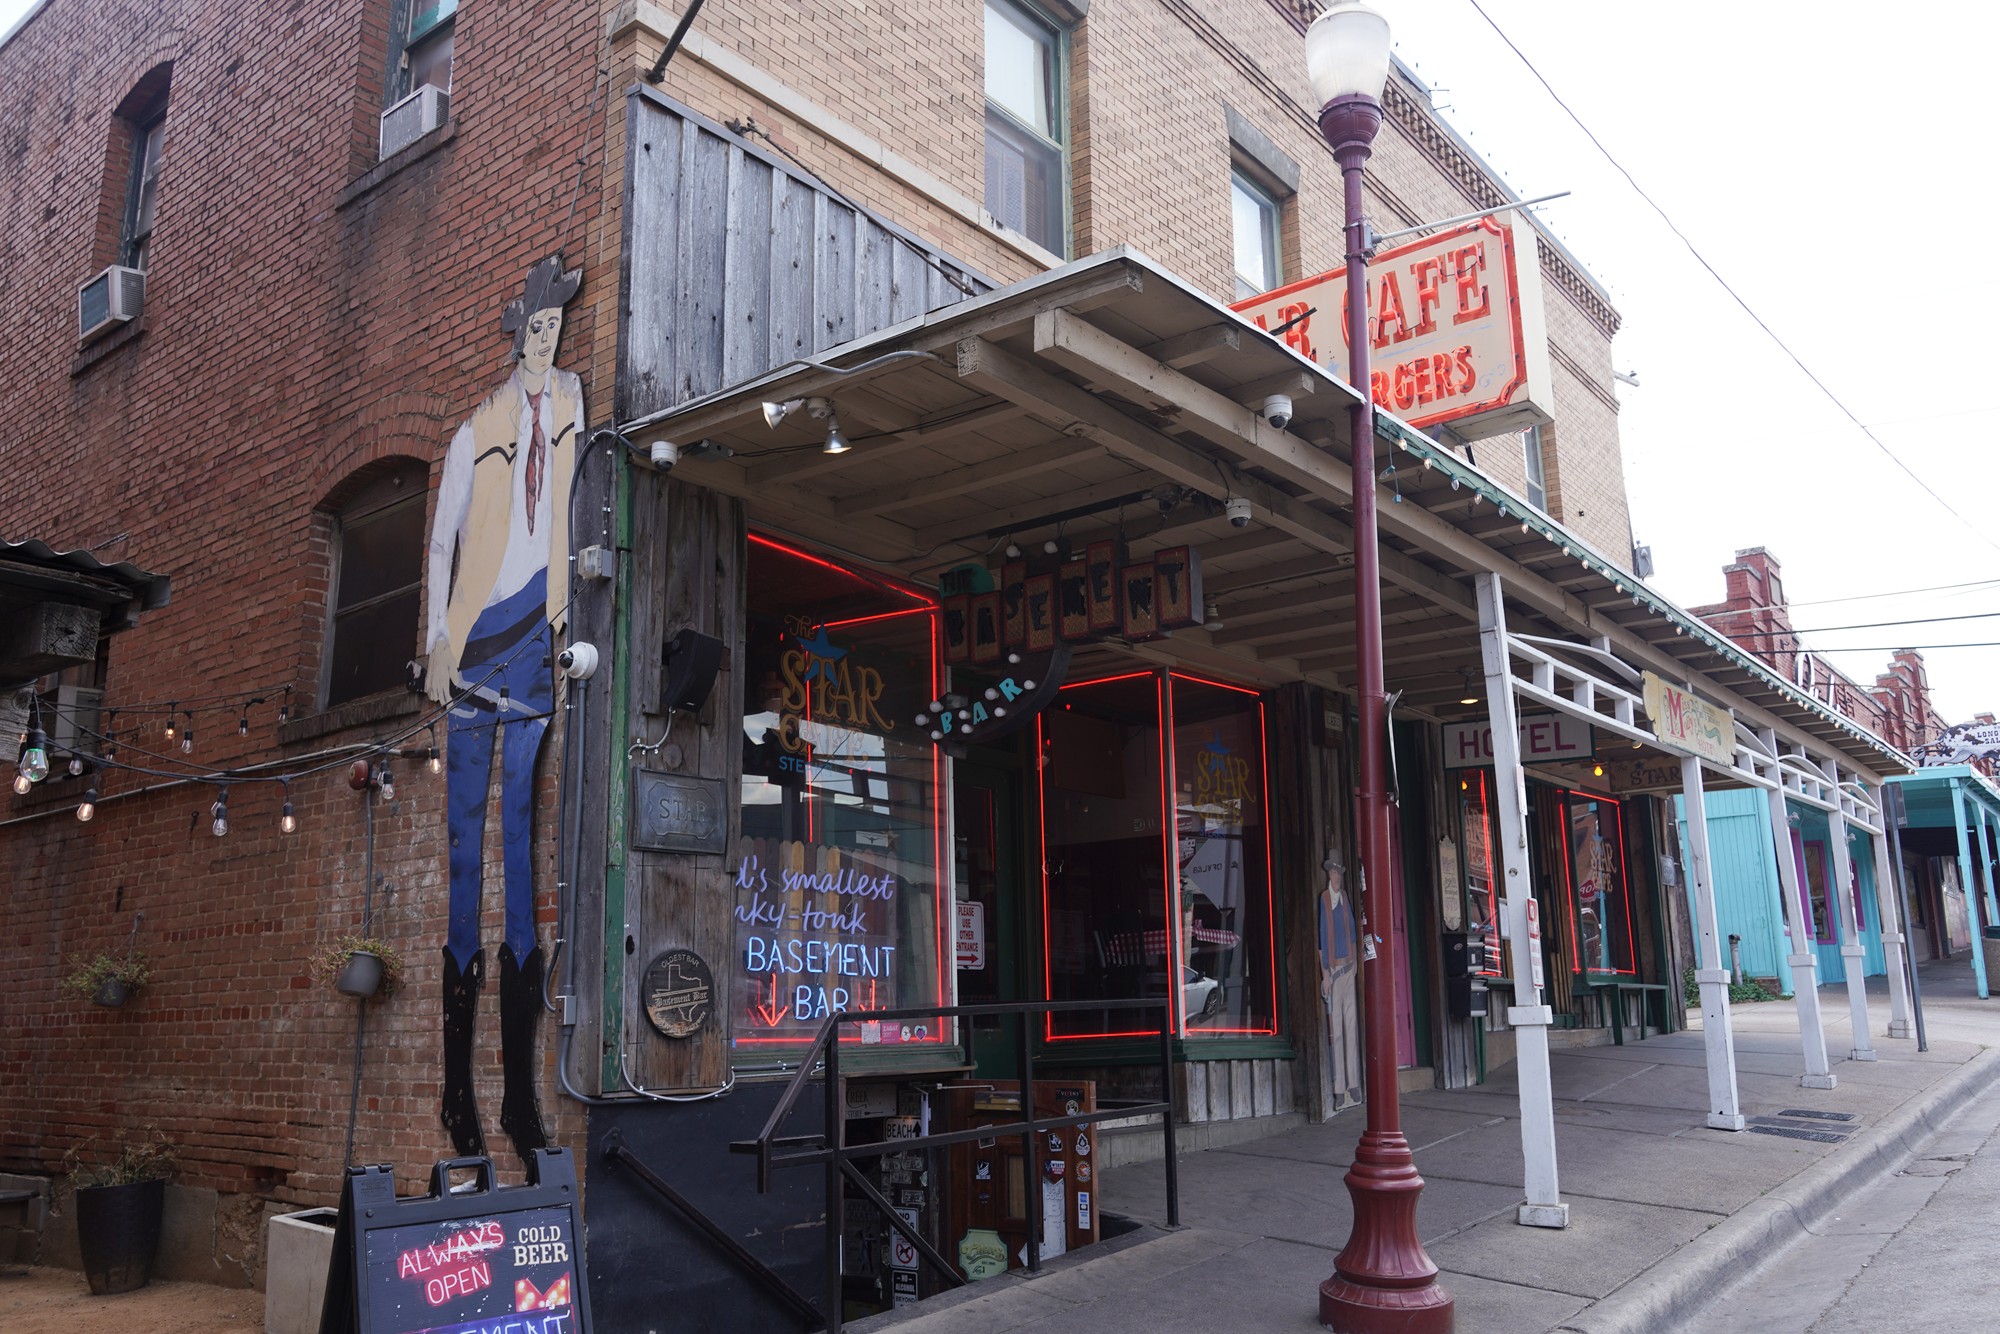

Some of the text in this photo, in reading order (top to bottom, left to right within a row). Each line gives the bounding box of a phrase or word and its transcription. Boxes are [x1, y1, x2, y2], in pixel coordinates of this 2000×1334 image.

[944, 560, 1184, 647] BASEMENT
[780, 649, 895, 733] STAR
[941, 677, 1023, 734] BAR
[1197, 750, 1256, 803] STAR
[659, 798, 706, 823] STAR
[782, 869, 895, 900] smallest
[958, 906, 974, 917] PLEASE
[962, 918, 971, 928] USE
[960, 930, 974, 940] OTHER
[661, 953, 700, 968] OLDEST BAR
[748, 937, 895, 977] BASEMENT
[655, 991, 708, 1008] Basement Bar
[795, 985, 849, 1020] BAR
[887, 1123, 912, 1138] BEACH
[518, 1226, 561, 1244] COLD
[401, 1222, 504, 1279] ALWAYS
[513, 1243, 568, 1267] BEER
[427, 1263, 490, 1304] OPEN
